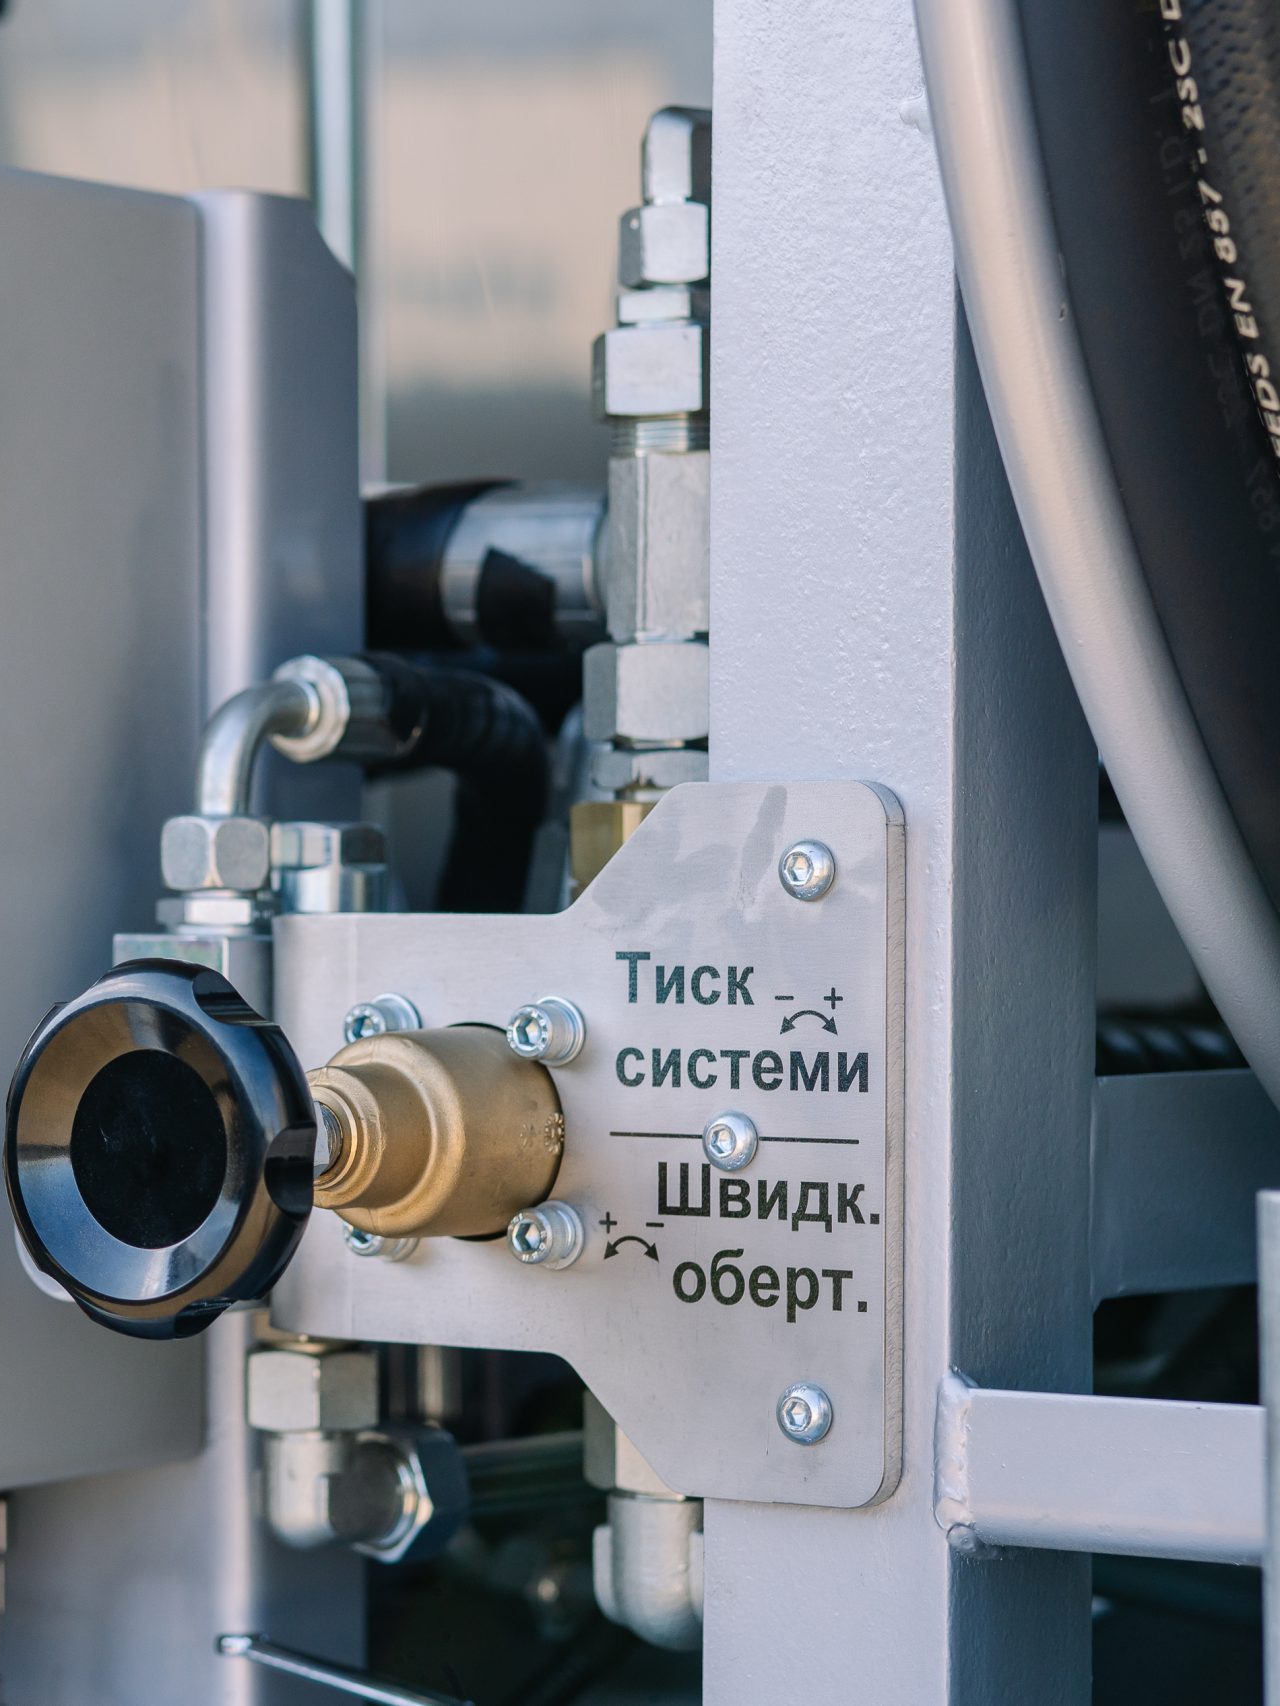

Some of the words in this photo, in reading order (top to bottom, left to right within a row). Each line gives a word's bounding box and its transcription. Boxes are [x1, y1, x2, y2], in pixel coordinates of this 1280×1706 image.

[1167, 38, 1205, 131] 2SC
[1197, 180, 1236, 264] 857
[1224, 277, 1260, 338] EN
[615, 951, 755, 1006] Тиск
[615, 1046, 870, 1094] системи
[657, 1161, 881, 1234] Швидк.
[672, 1248, 868, 1323] оберт.
